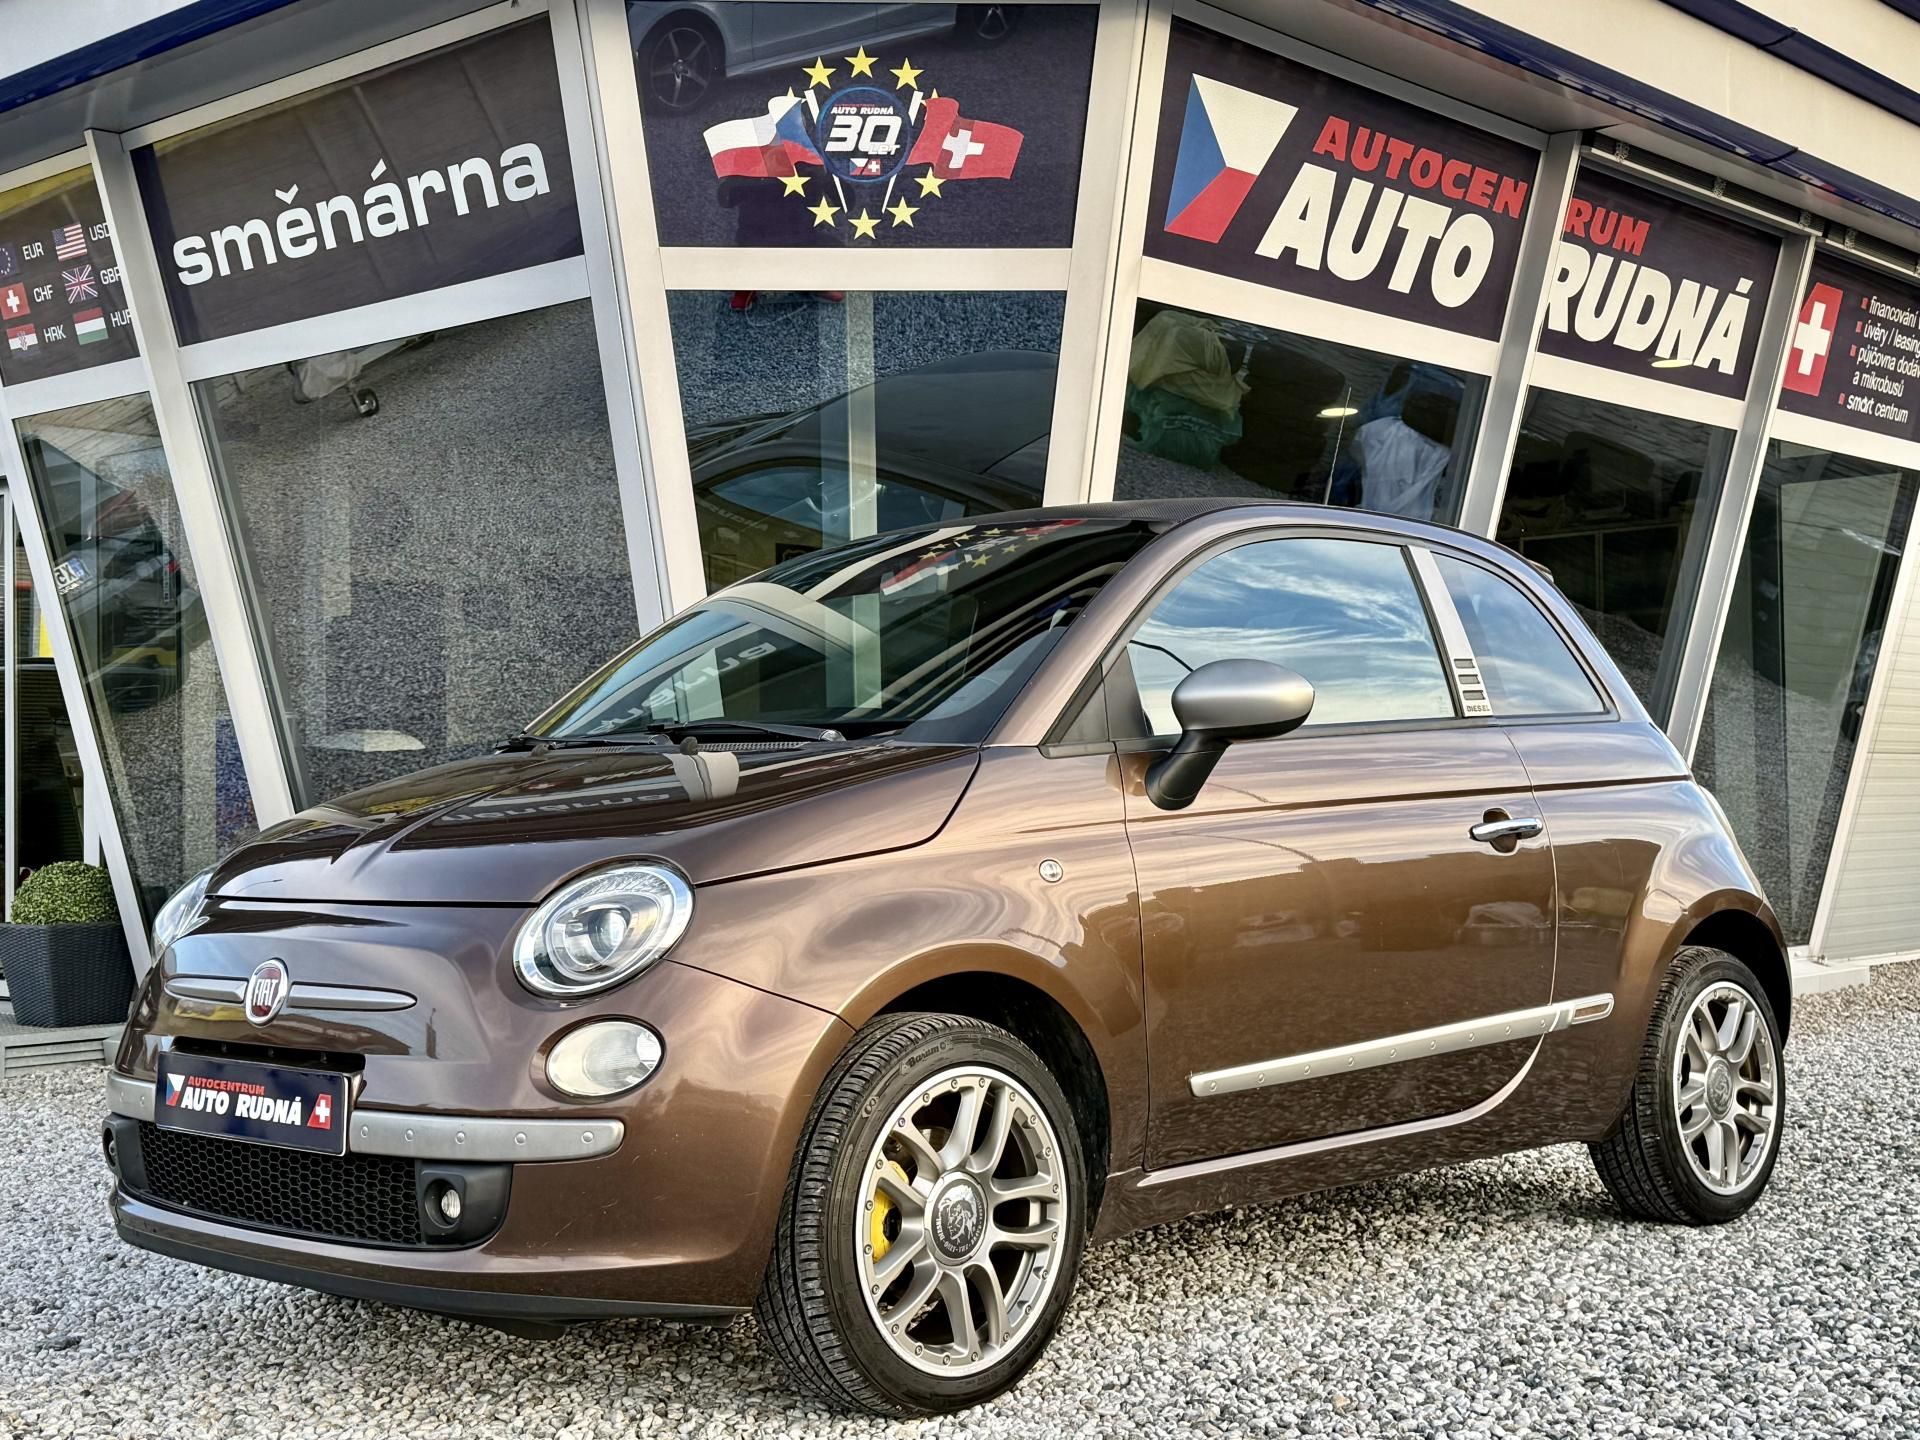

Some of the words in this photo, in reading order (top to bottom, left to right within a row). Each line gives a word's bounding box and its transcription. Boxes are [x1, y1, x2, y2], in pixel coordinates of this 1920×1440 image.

[831, 106, 857, 114] AUTO
[825, 115, 902, 152] 30
[173, 142, 550, 286] směnárna
[1254, 162, 1494, 308] AUTO
[22, 242, 44, 260] EUR
[33, 284, 53, 302] CHF
[1547, 241, 1754, 375] RUDNÁ
[1869, 296, 1918, 329] financování
[43, 324, 66, 343] HRK
[1863, 319, 1888, 347] úvěry
[1856, 345, 1895, 371] půjčovna
[1852, 370, 1860, 385] a
[1860, 371, 1904, 397] mikrobusů
[1874, 402, 1909, 423] centrum
[1466, 704, 1490, 712] DIESEL
[253, 979, 279, 1006] FIAT
[907, 1046, 939, 1068] Barum
[188, 1076, 265, 1095] AUTOCENTRUM
[181, 1087, 229, 1115] AUTO
[235, 1093, 302, 1126] RUDNÁ
